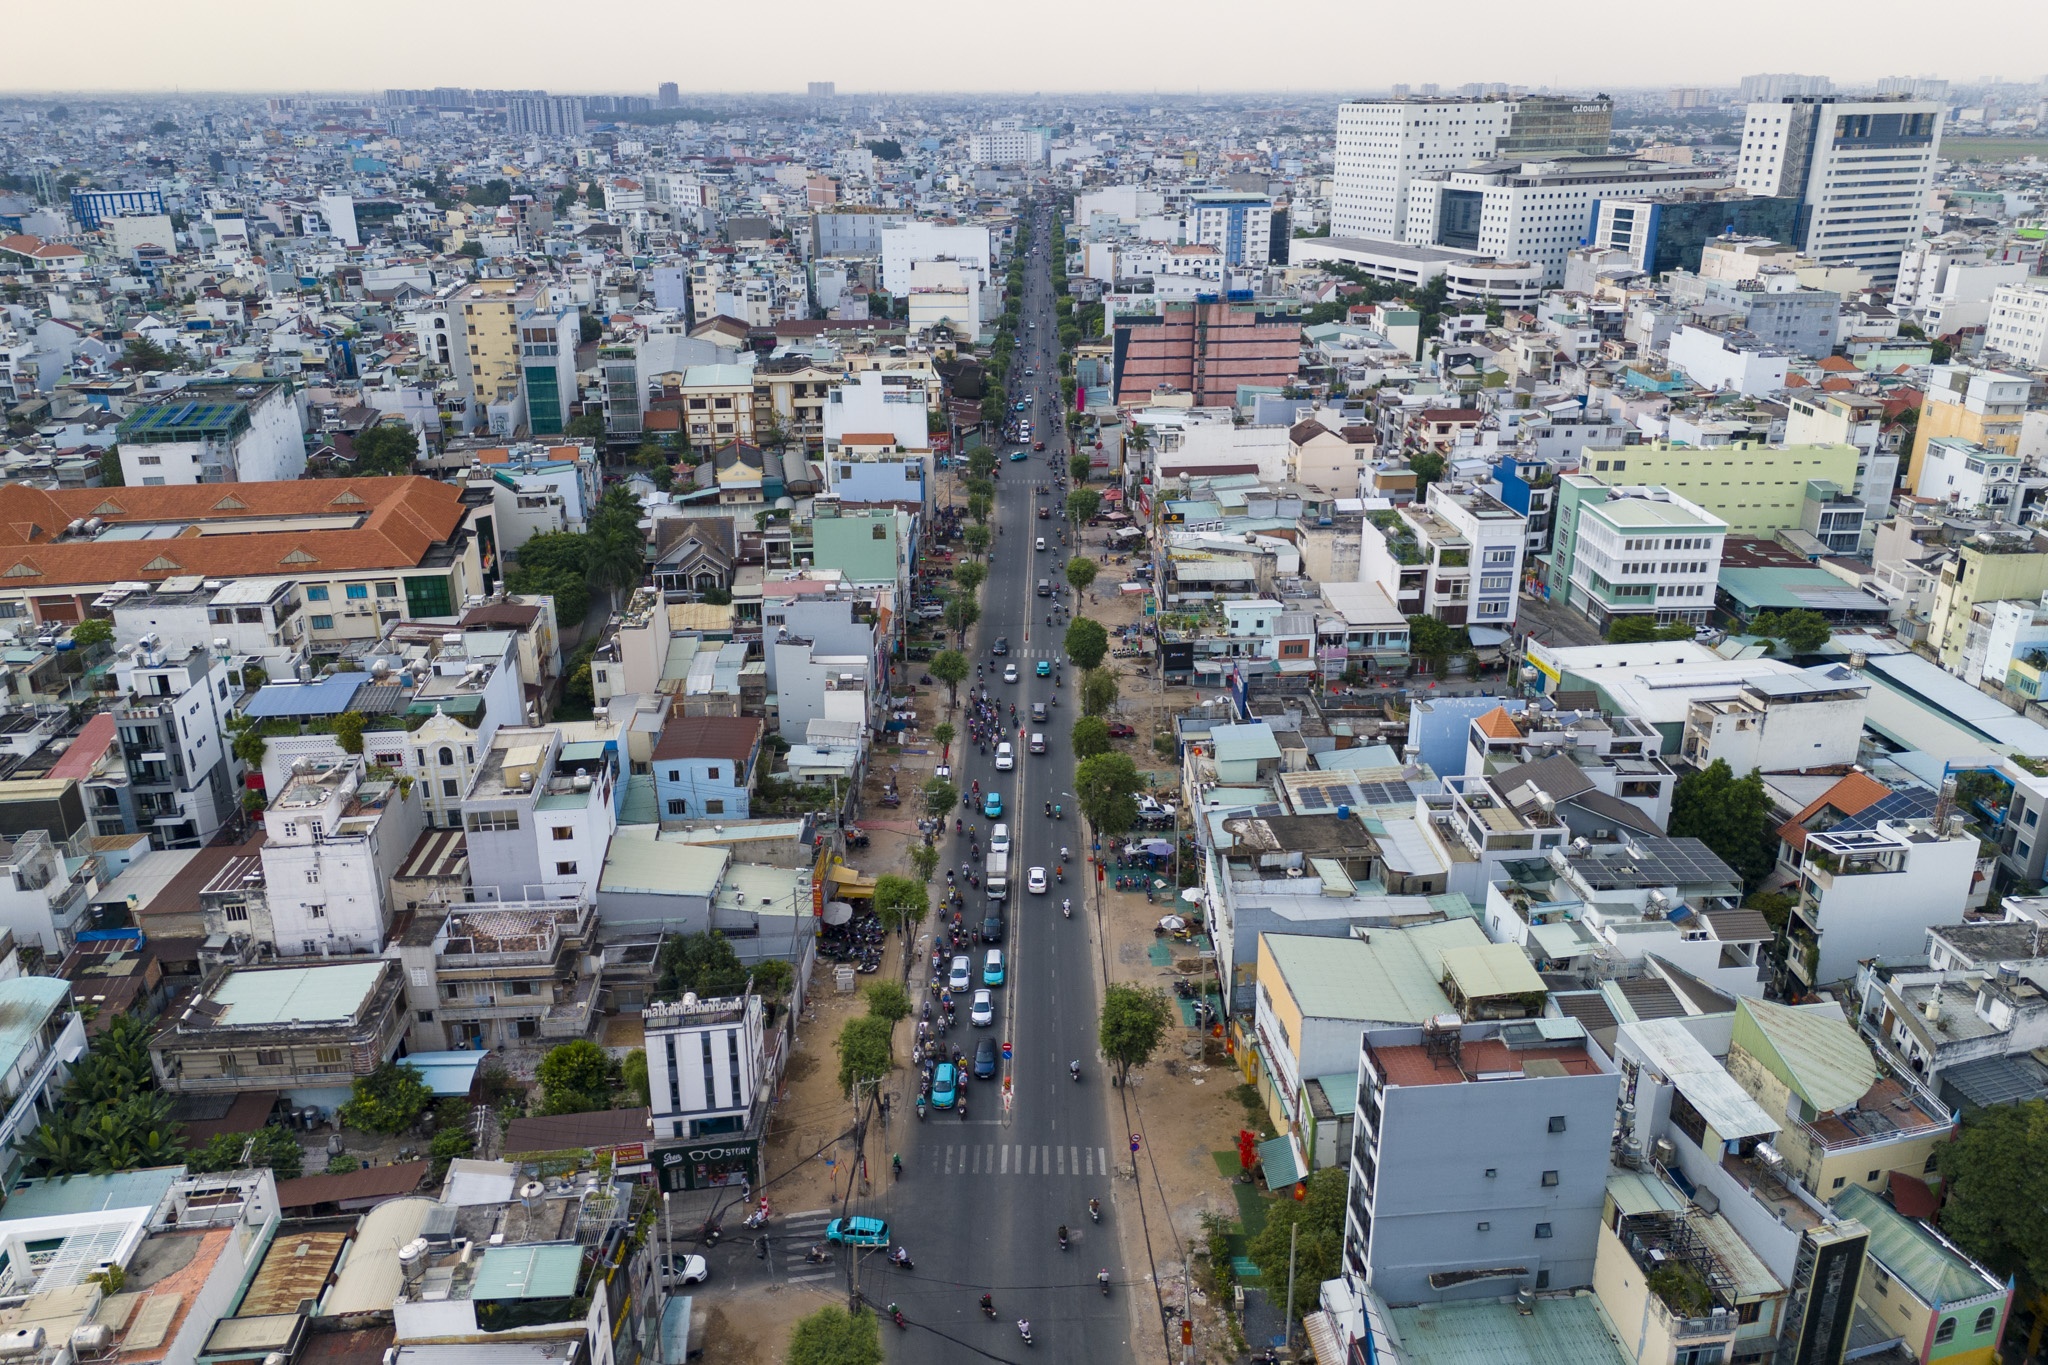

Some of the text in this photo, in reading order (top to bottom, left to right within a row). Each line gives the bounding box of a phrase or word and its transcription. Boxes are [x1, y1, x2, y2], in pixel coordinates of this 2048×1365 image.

[1572, 102, 1608, 113] e.town 6
[726, 1147, 751, 1157] STORY
